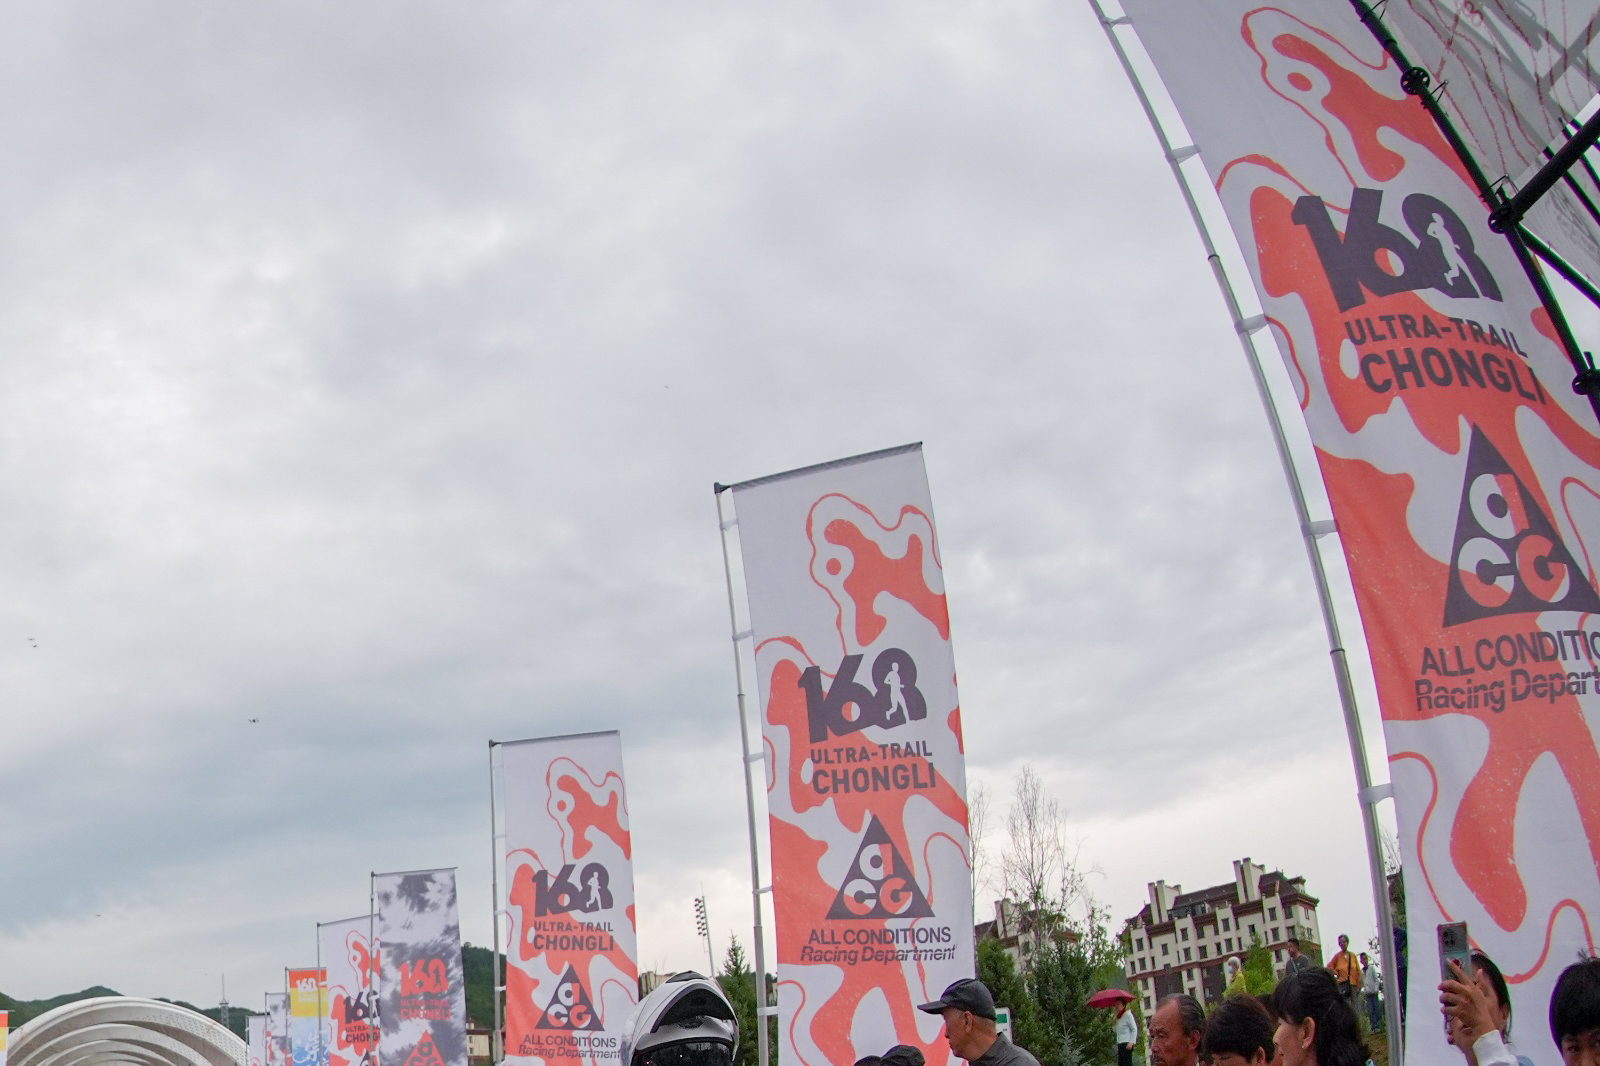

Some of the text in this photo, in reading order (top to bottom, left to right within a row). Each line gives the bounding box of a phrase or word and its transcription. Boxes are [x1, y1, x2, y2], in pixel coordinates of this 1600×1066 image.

[1345, 313, 1528, 358] ULTRA-TRAIL
[1361, 347, 1547, 405] CHONGLI
[1421, 645, 1475, 676] ALL
[1415, 678, 1505, 713] Racing
[810, 740, 933, 764] ULTRA-TRAIL
[812, 762, 937, 794] CHONGLI
[534, 921, 614, 932] ULTRA-TRAIL
[808, 926, 952, 945] ALL CONDITIONS
[533, 934, 615, 951] CHONGLI
[801, 944, 956, 965] Racing Department
[523, 1034, 617, 1048] ALL CONDITIONS
[518, 1045, 621, 1060] Racing Department
